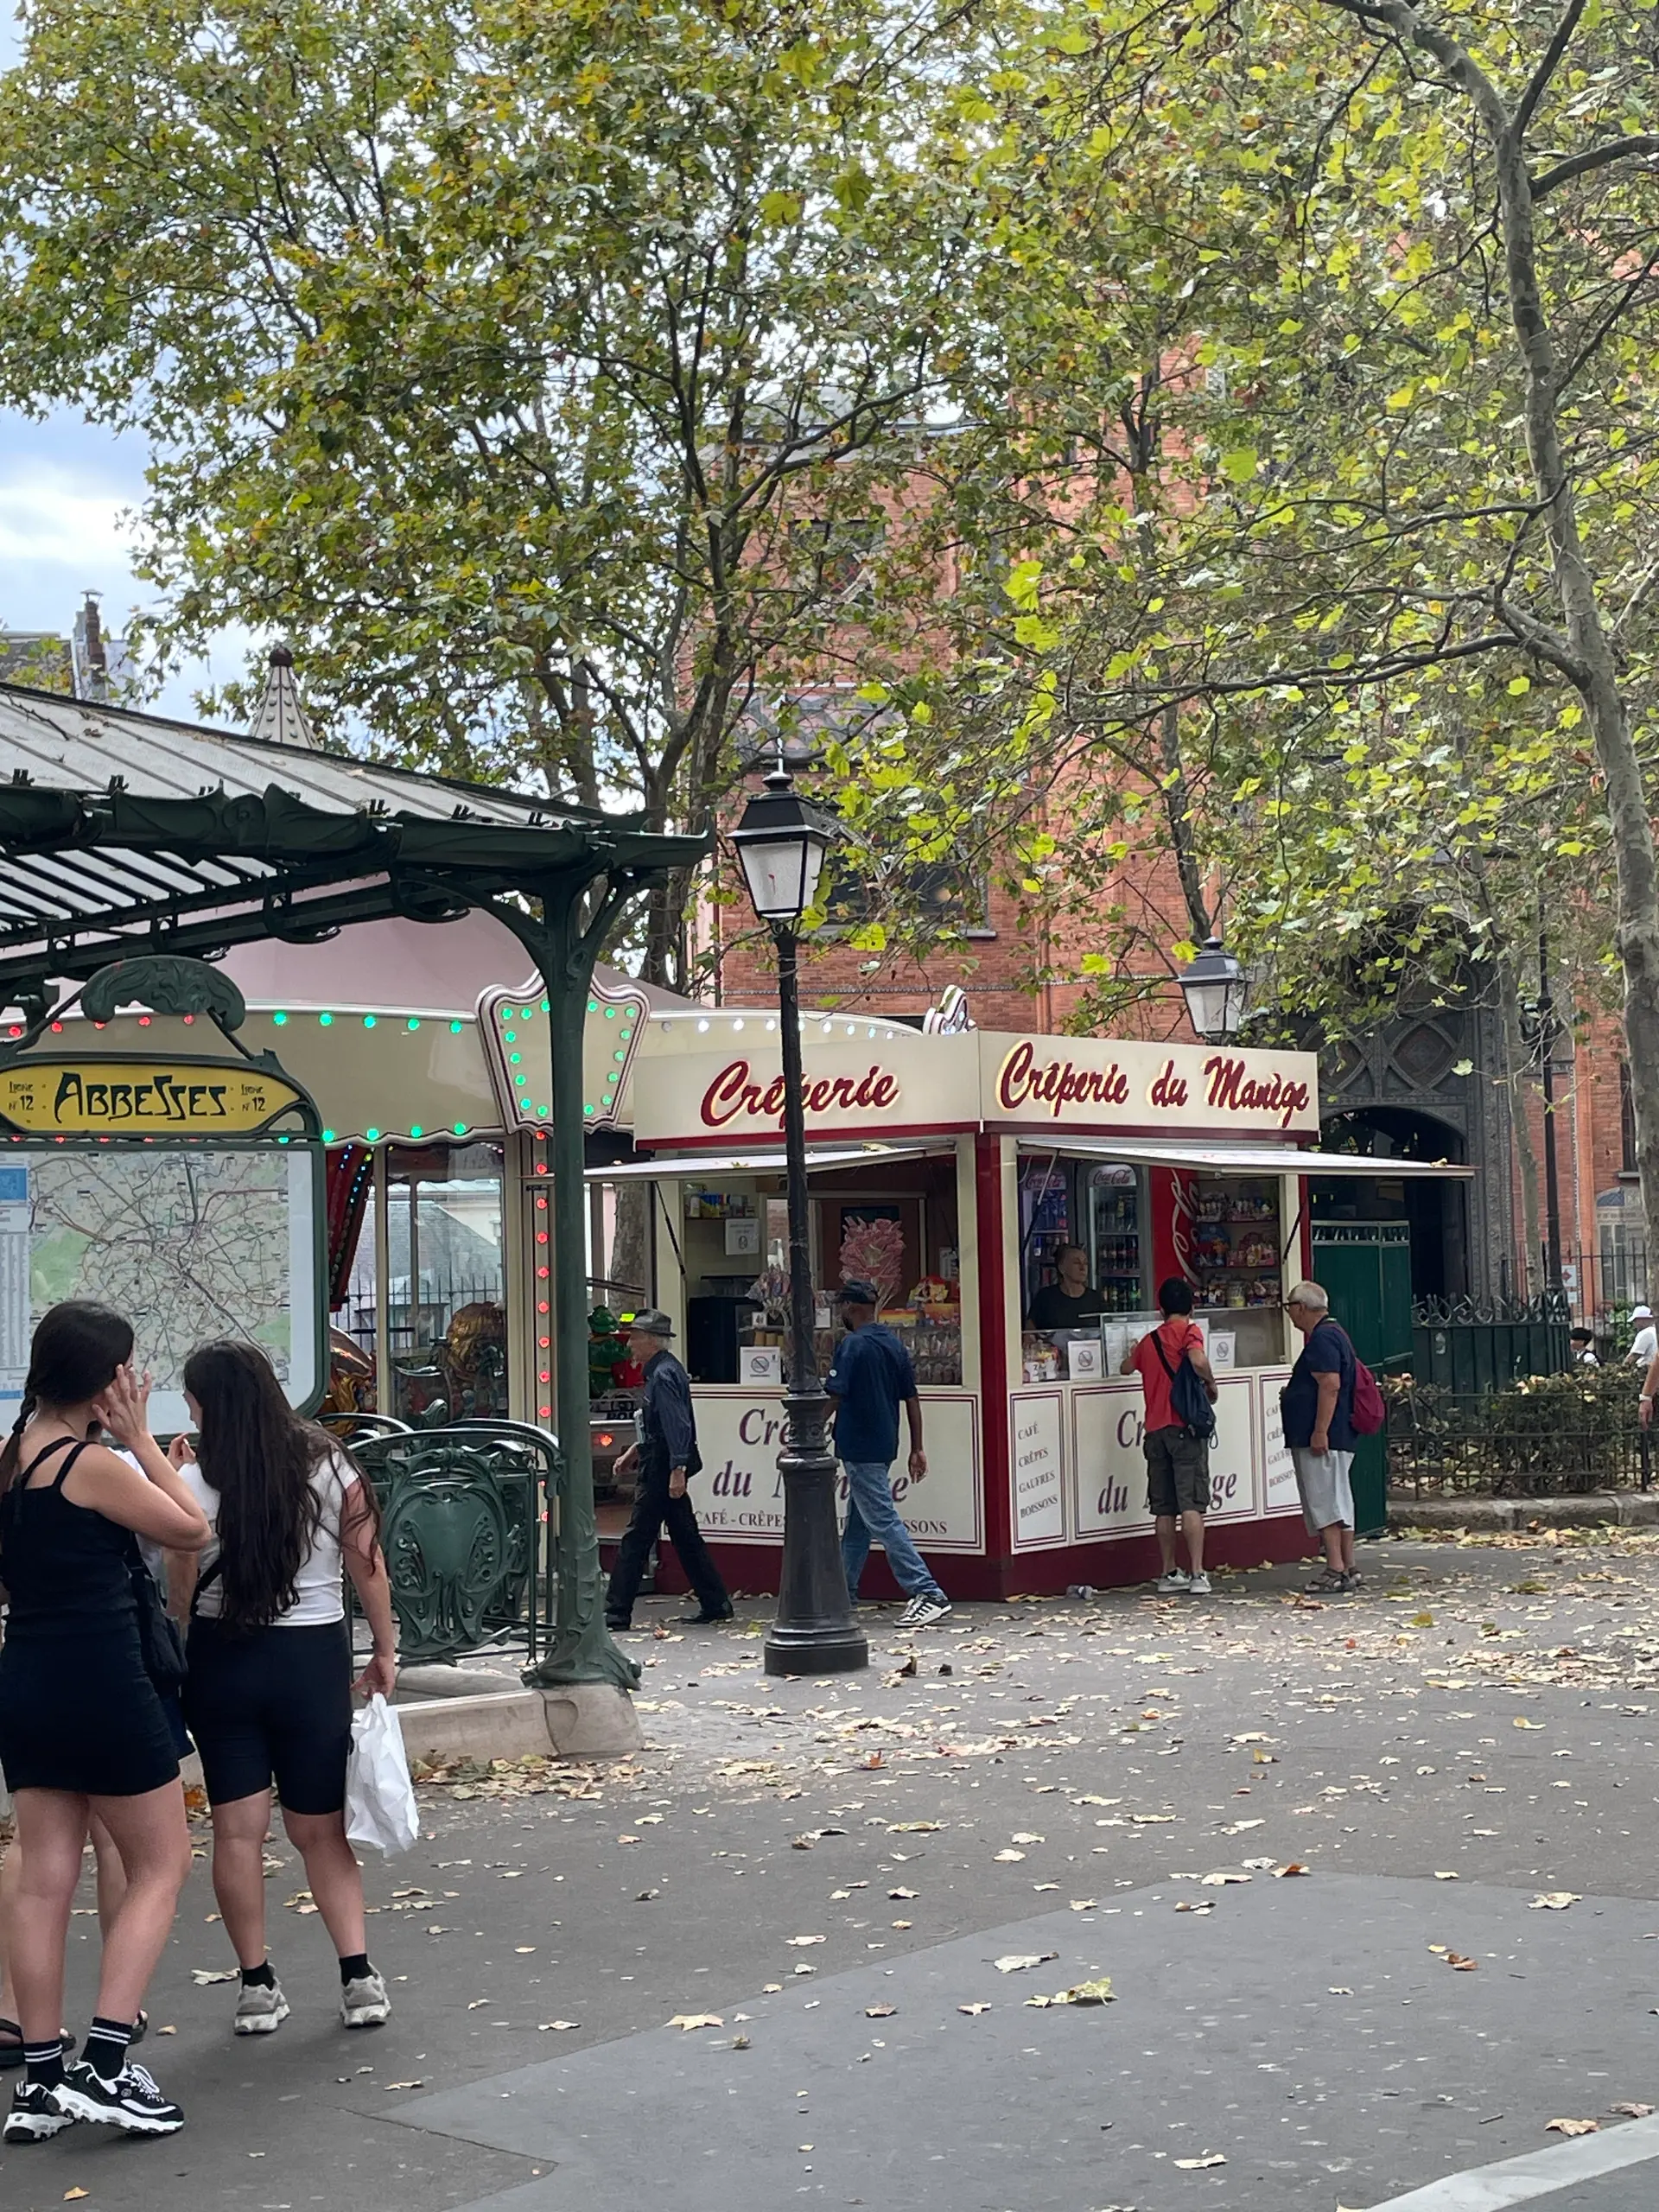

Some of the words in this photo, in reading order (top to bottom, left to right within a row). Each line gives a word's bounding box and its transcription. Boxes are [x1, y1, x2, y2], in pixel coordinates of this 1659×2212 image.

[999, 1041, 1130, 1117] Crêperie
[1150, 1059, 1189, 1108] du
[1204, 1055, 1311, 1128] Manège
[20, 1095, 34, 1110] 12
[54, 1071, 227, 1124] ABBESSES
[251, 1096, 266, 1112] 12
[1017, 1421, 1039, 1440] CAFÉ
[1018, 1446, 1049, 1467] CRÊPES
[711, 1460, 753, 1498] du
[1097, 1474, 1128, 1515] du
[739, 1510, 785, 1528] CRÊPE
